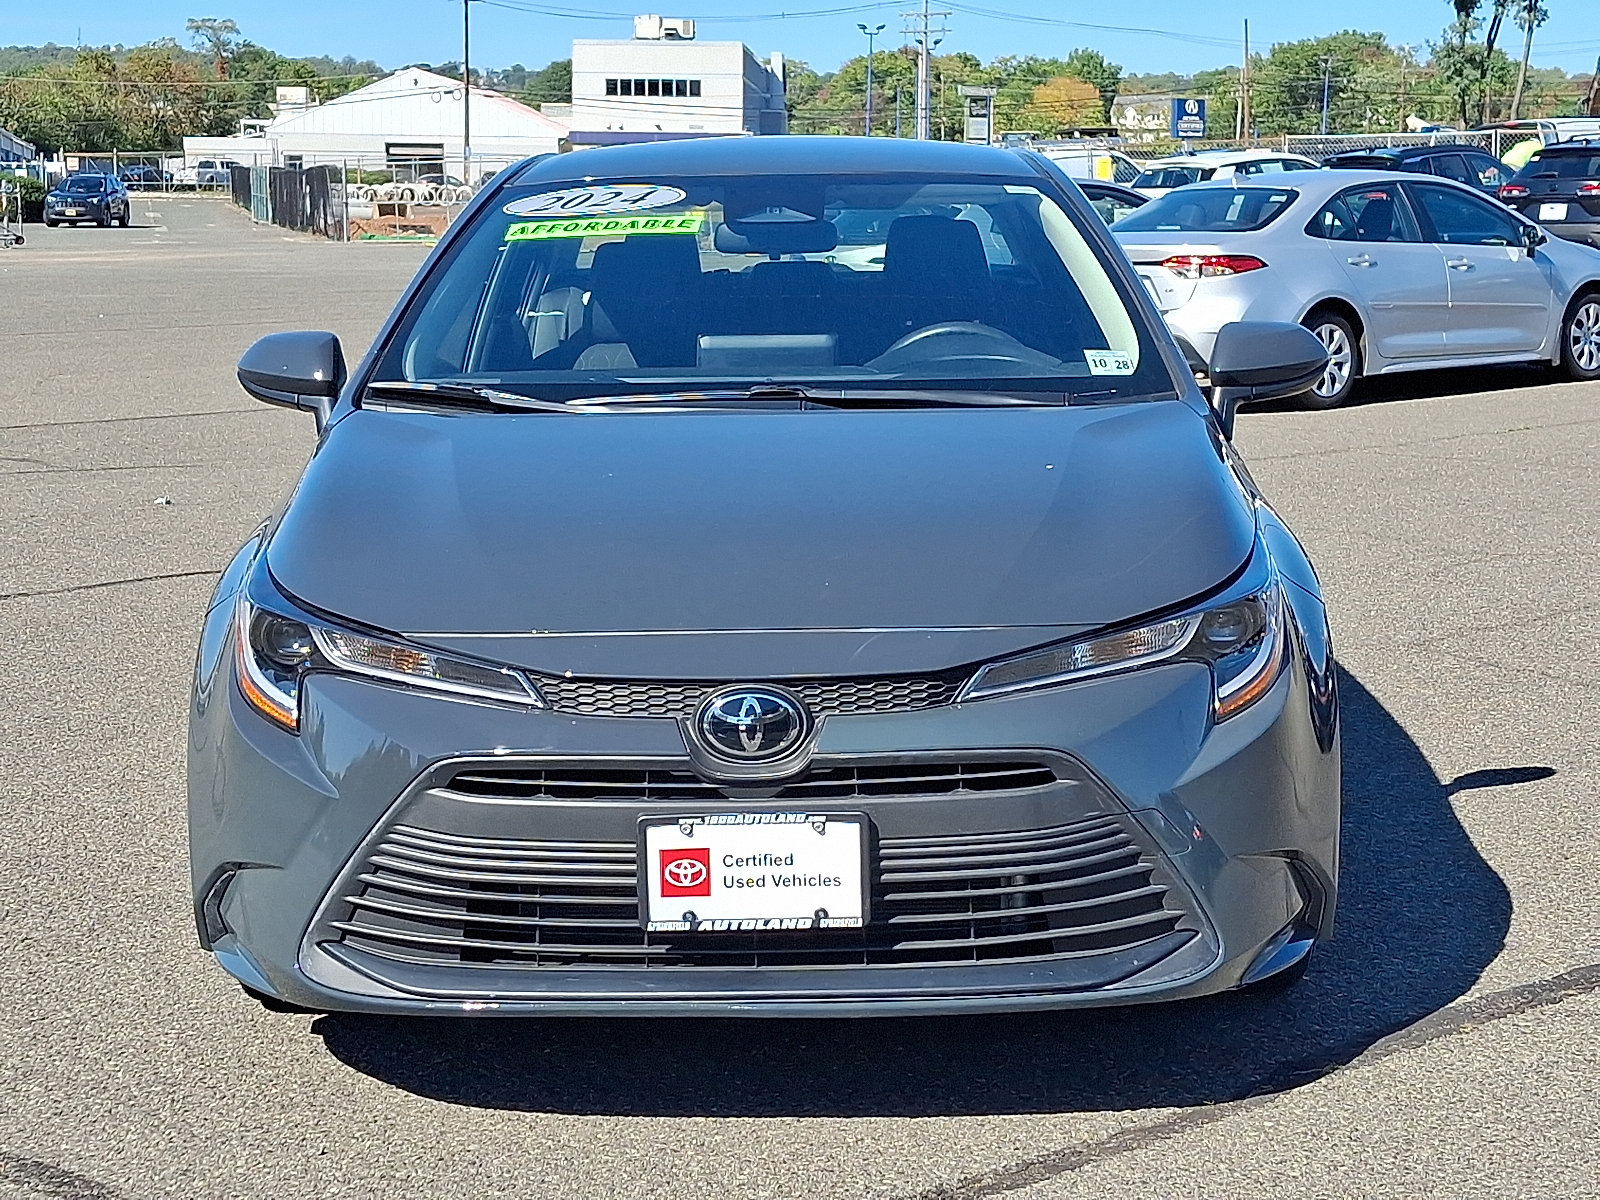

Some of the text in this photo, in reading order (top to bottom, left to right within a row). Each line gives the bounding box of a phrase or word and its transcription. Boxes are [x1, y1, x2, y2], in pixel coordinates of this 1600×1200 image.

[527, 188, 654, 213] 2024
[510, 217, 698, 237] AFFORDABLE
[1091, 358, 1130, 370] 10 28
[722, 853, 795, 868] Certified
[723, 873, 842, 889] Used Vehicles
[697, 918, 813, 932] AUTOLAND
